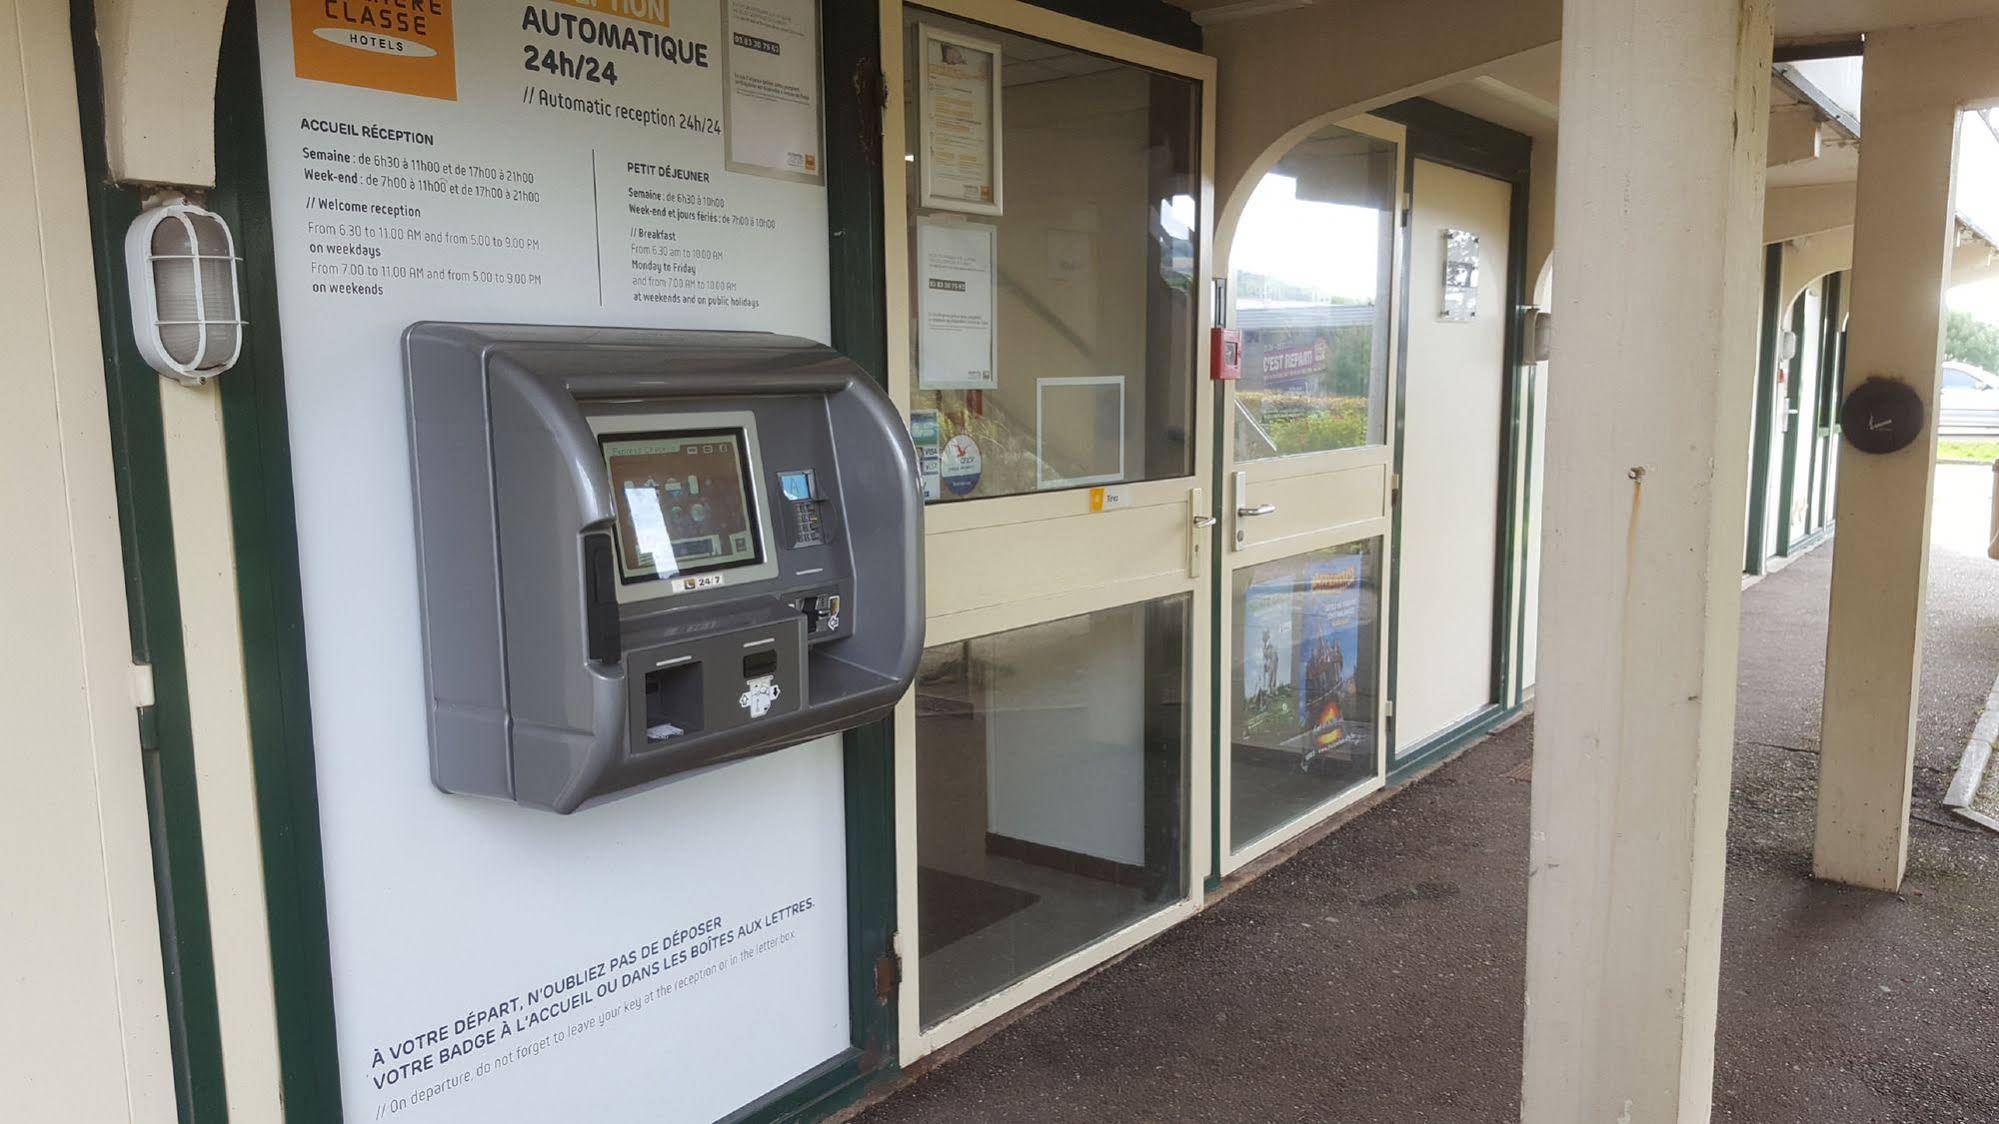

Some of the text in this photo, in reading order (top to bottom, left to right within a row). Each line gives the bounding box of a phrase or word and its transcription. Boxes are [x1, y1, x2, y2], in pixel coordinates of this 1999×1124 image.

[325, 0, 427, 36] CLASSE
[350, 34, 404, 52] HOTELS
[522, 6, 708, 68] AUTOMATIQUE
[524, 45, 618, 86] 24h/24
[539, 89, 612, 117] Automatic
[615, 104, 676, 127] reception
[679, 113, 721, 136] 24h/24
[301, 118, 434, 146] ACCUEIL RÉCEPTION
[358, 153, 371, 166] de
[374, 154, 400, 168] 6h30
[402, 158, 409, 170] à
[411, 160, 440, 173] 11h00
[442, 162, 453, 174] et
[454, 164, 466, 176] de
[469, 166, 497, 180] 17h00
[499, 168, 505, 181] à
[506, 168, 534, 184] 21h00
[627, 162, 710, 183] PETIT DÉJEUNER
[304, 168, 358, 184] Week-end
[366, 174, 378, 187] de
[382, 176, 407, 190] 7h00
[410, 178, 416, 190] à
[418, 178, 447, 192] 11h00
[450, 183, 460, 196] et
[462, 184, 473, 196] de
[475, 185, 502, 200] 17h00
[505, 188, 511, 200] à
[513, 188, 540, 203] 21h00
[318, 198, 368, 213] Welcome
[370, 202, 421, 219] reception
[666, 192, 676, 203] de
[677, 194, 696, 205] 6h30
[698, 196, 702, 206] à
[703, 196, 725, 208] 10h00
[628, 204, 667, 218] Week-end
[668, 208, 676, 219] et
[676, 208, 696, 222] jours
[722, 214, 731, 224] de
[732, 214, 750, 227] 7h00
[756, 218, 776, 230] 10h00
[308, 222, 540, 251] From 6.30 to 11.00 AM and from 5.00 to 9.00 PM
[638, 228, 676, 242] Breakfast
[310, 243, 382, 260] on weekdays
[631, 244, 650, 256] From
[669, 248, 682, 258] am
[683, 248, 692, 258] to
[712, 250, 724, 261] AM
[312, 262, 542, 286] From 7.00 to 11.00 AM and from 5.00 to 9.00 PM
[632, 260, 696, 276] Monday to Friday
[312, 281, 384, 296] on weekends
[632, 276, 647, 288] and
[648, 277, 668, 289] from
[684, 278, 696, 290] AM
[698, 280, 706, 290] to
[726, 282, 736, 292] AM
[633, 292, 760, 308] at weekends and on public holidays
[1263, 354, 1284, 373] C'EST
[372, 916, 722, 1068] À VOTRE DÉPART, N'OUBLIEZ PAS DE DÉPOSER
[372, 896, 816, 1090] VOTRE BADGE À L'ACCUEIL OU DANS LES BOÎTES AUX LETTRES.
[390, 1098, 407, 1114] On
[410, 1070, 474, 1106] departure,
[476, 1062, 491, 1078] do
[494, 1050, 514, 1069] not
[516, 1034, 551, 1060] forget
[553, 1031, 565, 1044] to
[568, 1016, 596, 1038] leave
[598, 1003, 622, 1028] your
[624, 996, 642, 1014] key
[644, 992, 654, 1005] at
[656, 984, 672, 999] the
[674, 963, 717, 992] reception
[719, 960, 729, 972] or
[730, 954, 738, 967] in
[740, 946, 754, 962] the
[756, 936, 778, 955] letter
